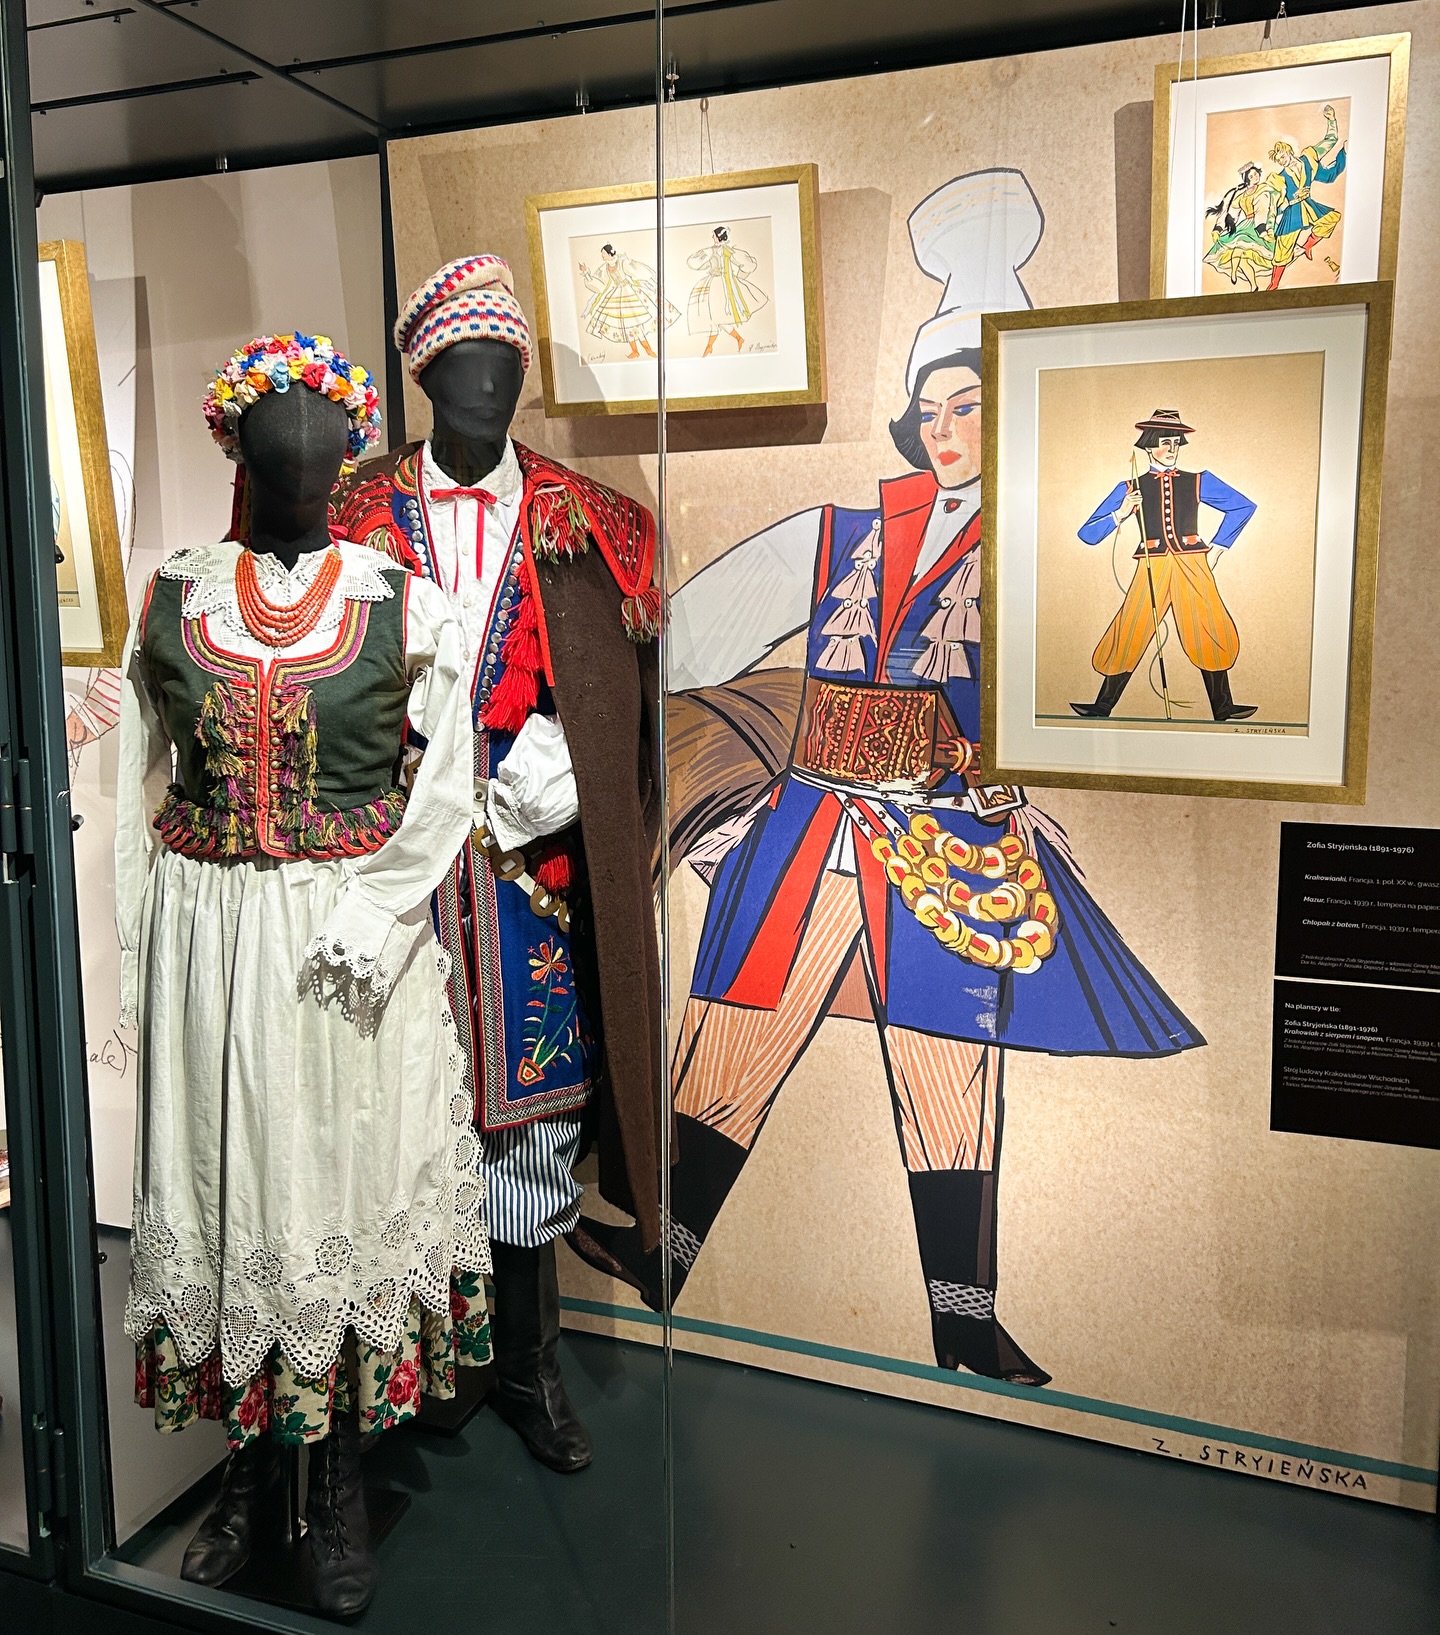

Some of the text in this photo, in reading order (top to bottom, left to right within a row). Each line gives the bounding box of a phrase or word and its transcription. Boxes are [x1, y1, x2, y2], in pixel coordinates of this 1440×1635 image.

[1306, 841, 1415, 854] Zofia Stryjeńska (1891-1976)
[1377, 901, 1406, 909] tempera
[1302, 919, 1330, 927] Chłopak
[1336, 921, 1360, 929] batem,
[1296, 1003, 1321, 1012] planszy
[1284, 1019, 1378, 1033] Zofia Stryjeńska (1891-1976)
[1284, 1028, 1319, 1037] Krakowiak
[1283, 1066, 1410, 1084] Strój ludowy Krakowiaków Wschodnich
[1151, 1437, 1368, 1490] Z. STRYIEŃSKA
